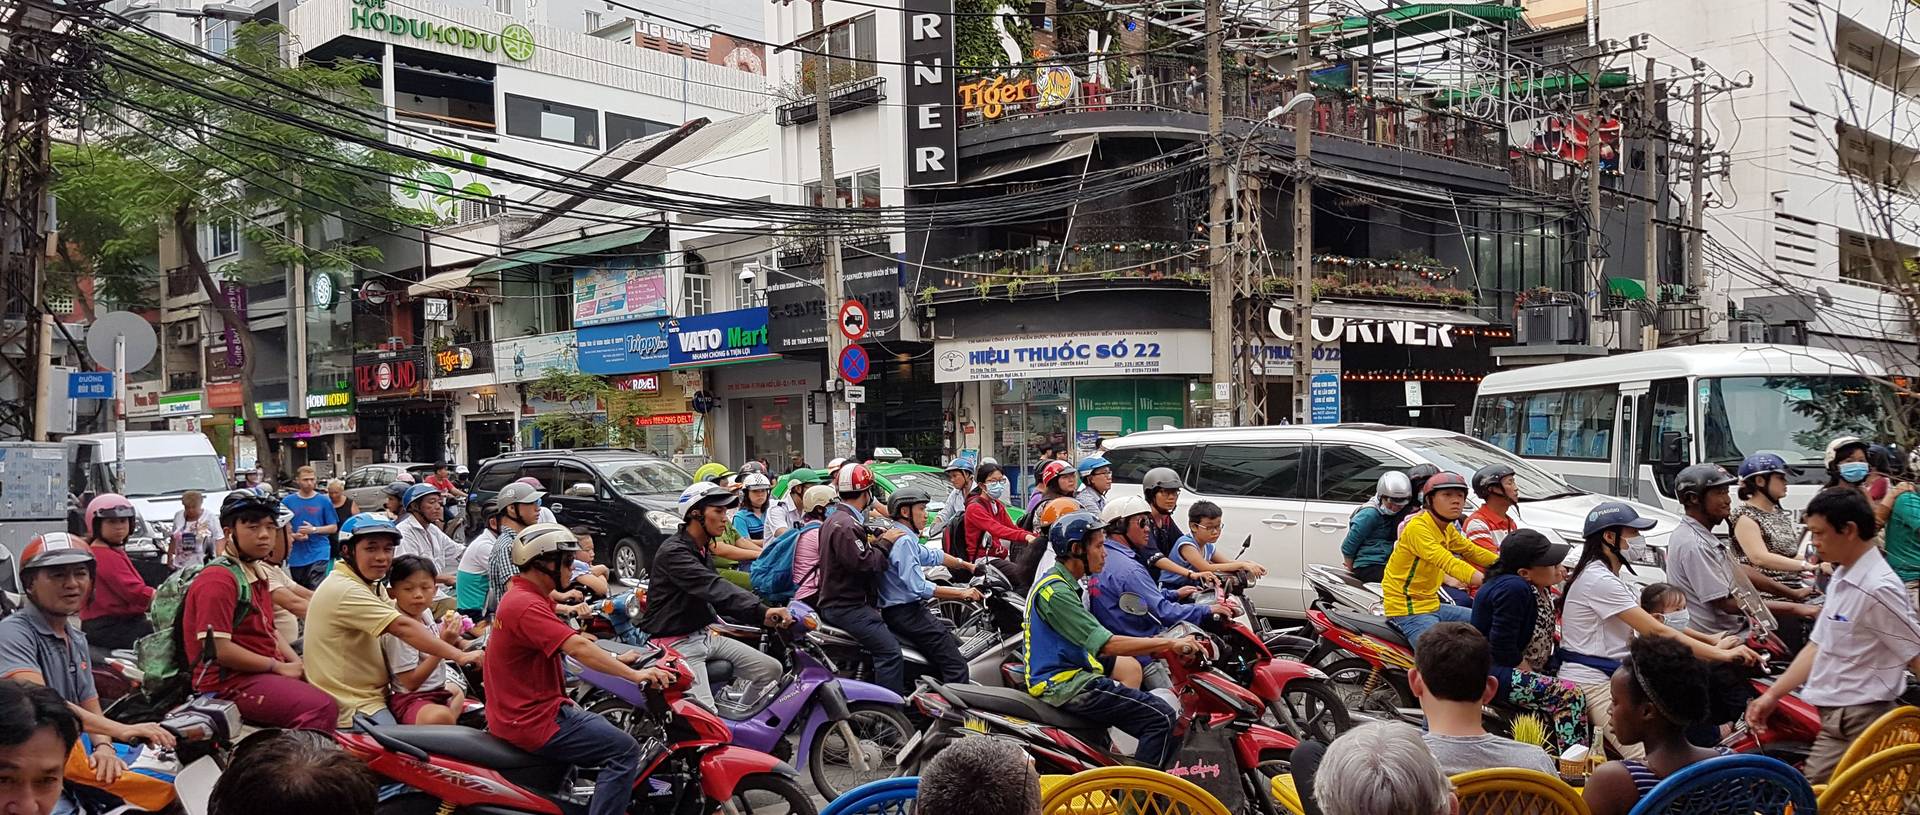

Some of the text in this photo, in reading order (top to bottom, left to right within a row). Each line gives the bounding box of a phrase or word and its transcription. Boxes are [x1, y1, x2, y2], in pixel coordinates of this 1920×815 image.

[959, 75, 1032, 118] Tiger
[874, 310, 881, 320] DE
[882, 308, 895, 319] THAM
[678, 324, 769, 353] VATO Mart
[436, 350, 460, 372] Tiger
[692, 351, 709, 361] NHANH
[968, 338, 1161, 366] HIỆU THUỐC SỐ 22
[1265, 343, 1295, 359] THUỐ
